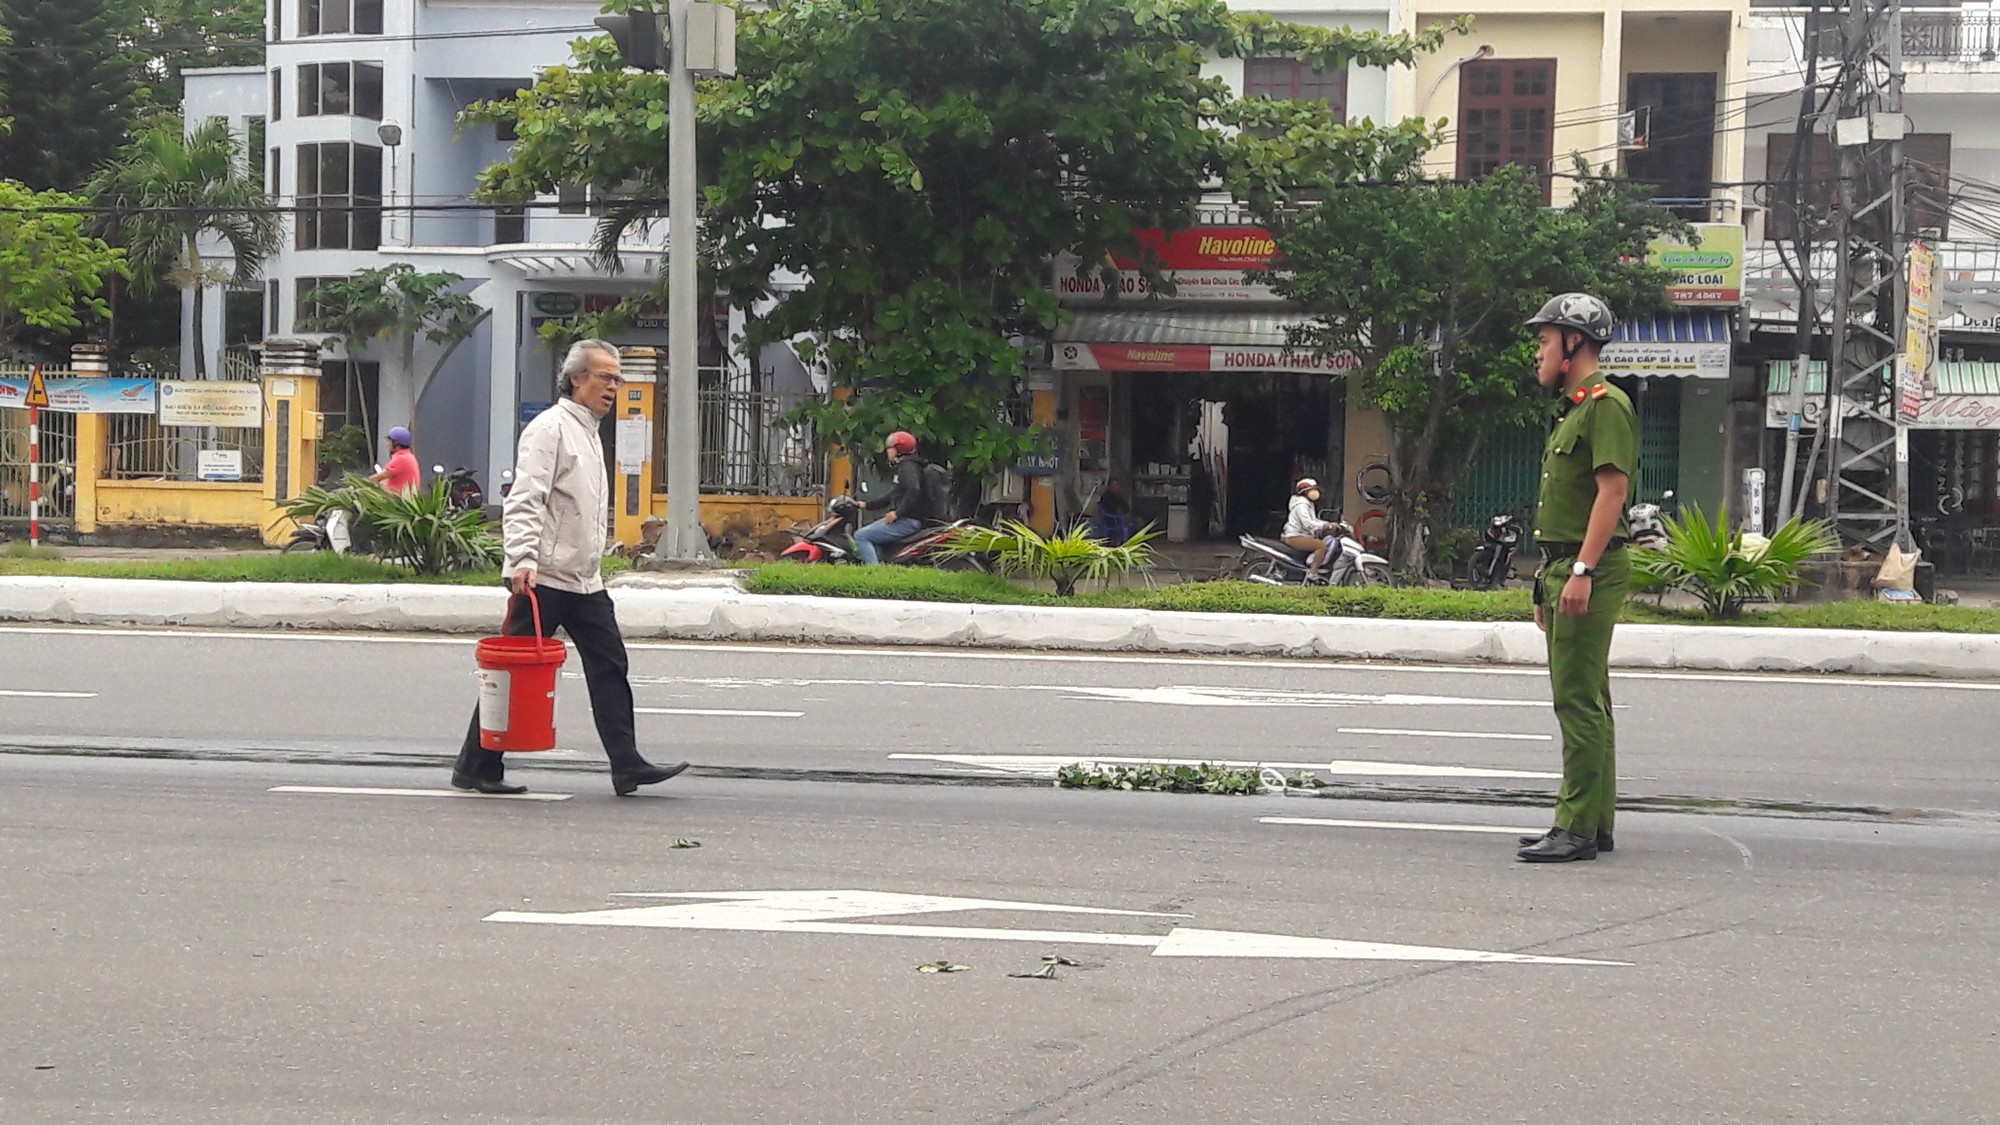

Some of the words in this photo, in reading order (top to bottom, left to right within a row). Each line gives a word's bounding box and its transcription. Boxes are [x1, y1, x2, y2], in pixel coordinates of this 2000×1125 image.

[1199, 236, 1276, 255] Havoline
[1060, 277, 1100, 293] HONDA
[1697, 274, 1723, 287] LOẠI
[1127, 350, 1175, 361] Havoline
[1225, 352, 1276, 367] HONDA
